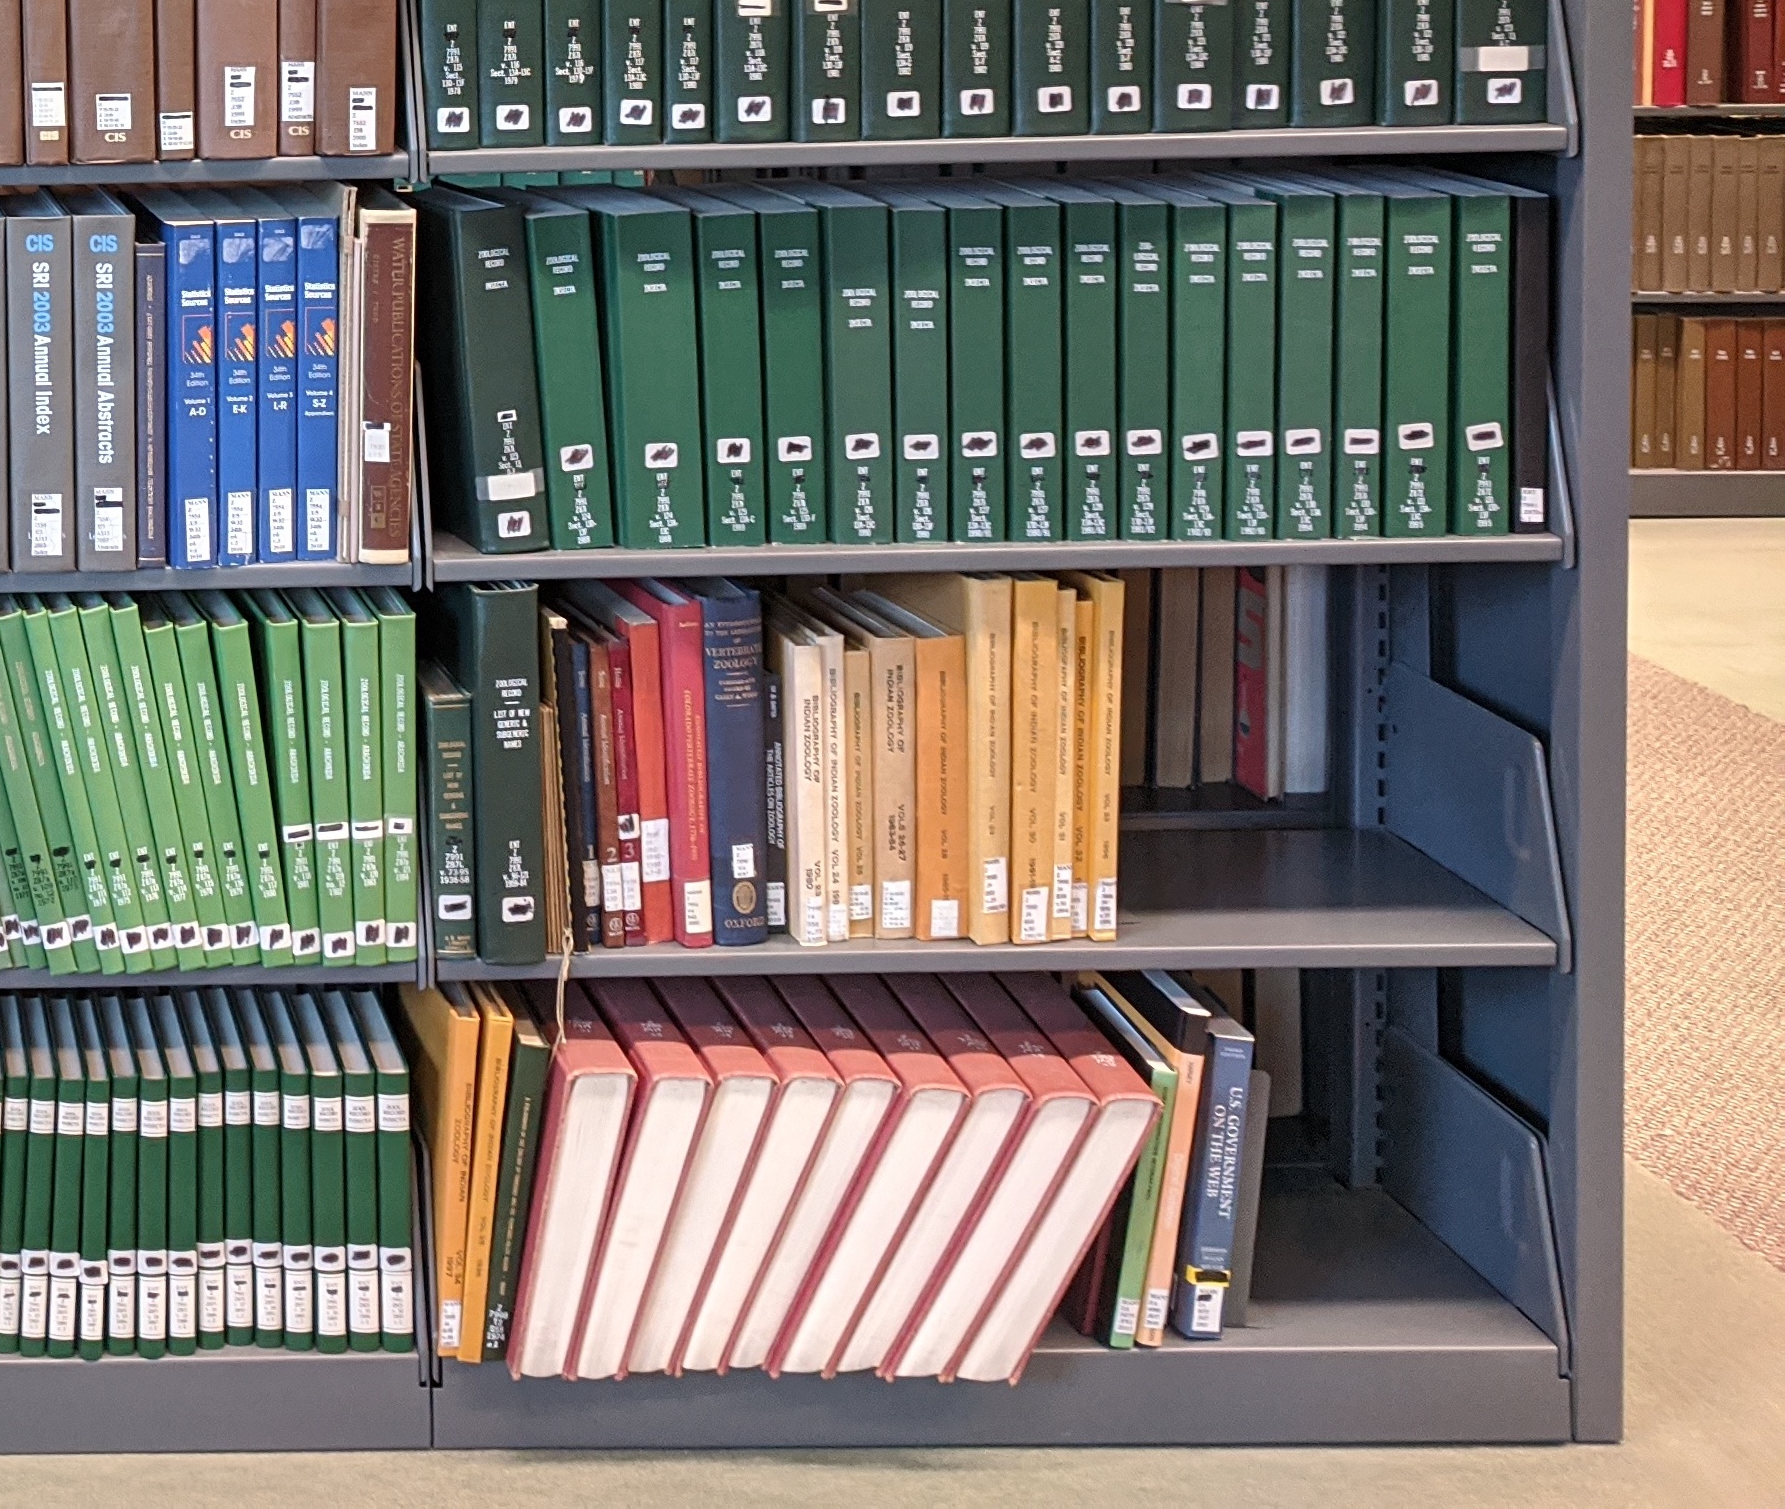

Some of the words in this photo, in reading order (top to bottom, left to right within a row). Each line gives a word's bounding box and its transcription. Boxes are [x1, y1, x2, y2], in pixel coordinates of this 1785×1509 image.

[104, 131, 128, 143] CIS
[229, 128, 253, 140] CIS
[25, 234, 54, 253] CIS
[89, 234, 119, 253] CIS
[31, 261, 51, 289] SRI
[95, 261, 114, 289] SRI
[32, 290, 51, 333] 2003
[95, 290, 114, 333] 2003
[33, 334, 51, 388] Annual
[96, 334, 114, 387] Annual
[35, 389, 51, 436] Index
[189, 407, 206, 416] A-D
[233, 404, 247, 414] E-K
[274, 401, 287, 411] L-R
[312, 399, 327, 408] S-Z
[97, 388, 114, 465] Abstracts
[713, 658, 759, 669] ZOOLOGY
[897, 665, 905, 739] BIBLIOGRAPHY
[812, 695, 821, 768] BIBLIOGRAPHY
[886, 705, 894, 753] ZOOLOGY
[804, 732, 812, 783] ZOOLOGY
[898, 740, 905, 753] OF
[813, 771, 820, 784] OF
[1228, 1087, 1243, 1111] U.S.
[1213, 1104, 1226, 1128] ON
[1210, 1131, 1223, 1164] THE
[1219, 1114, 1240, 1219] GOVERNMENT
[1206, 1166, 1221, 1198] WEB
